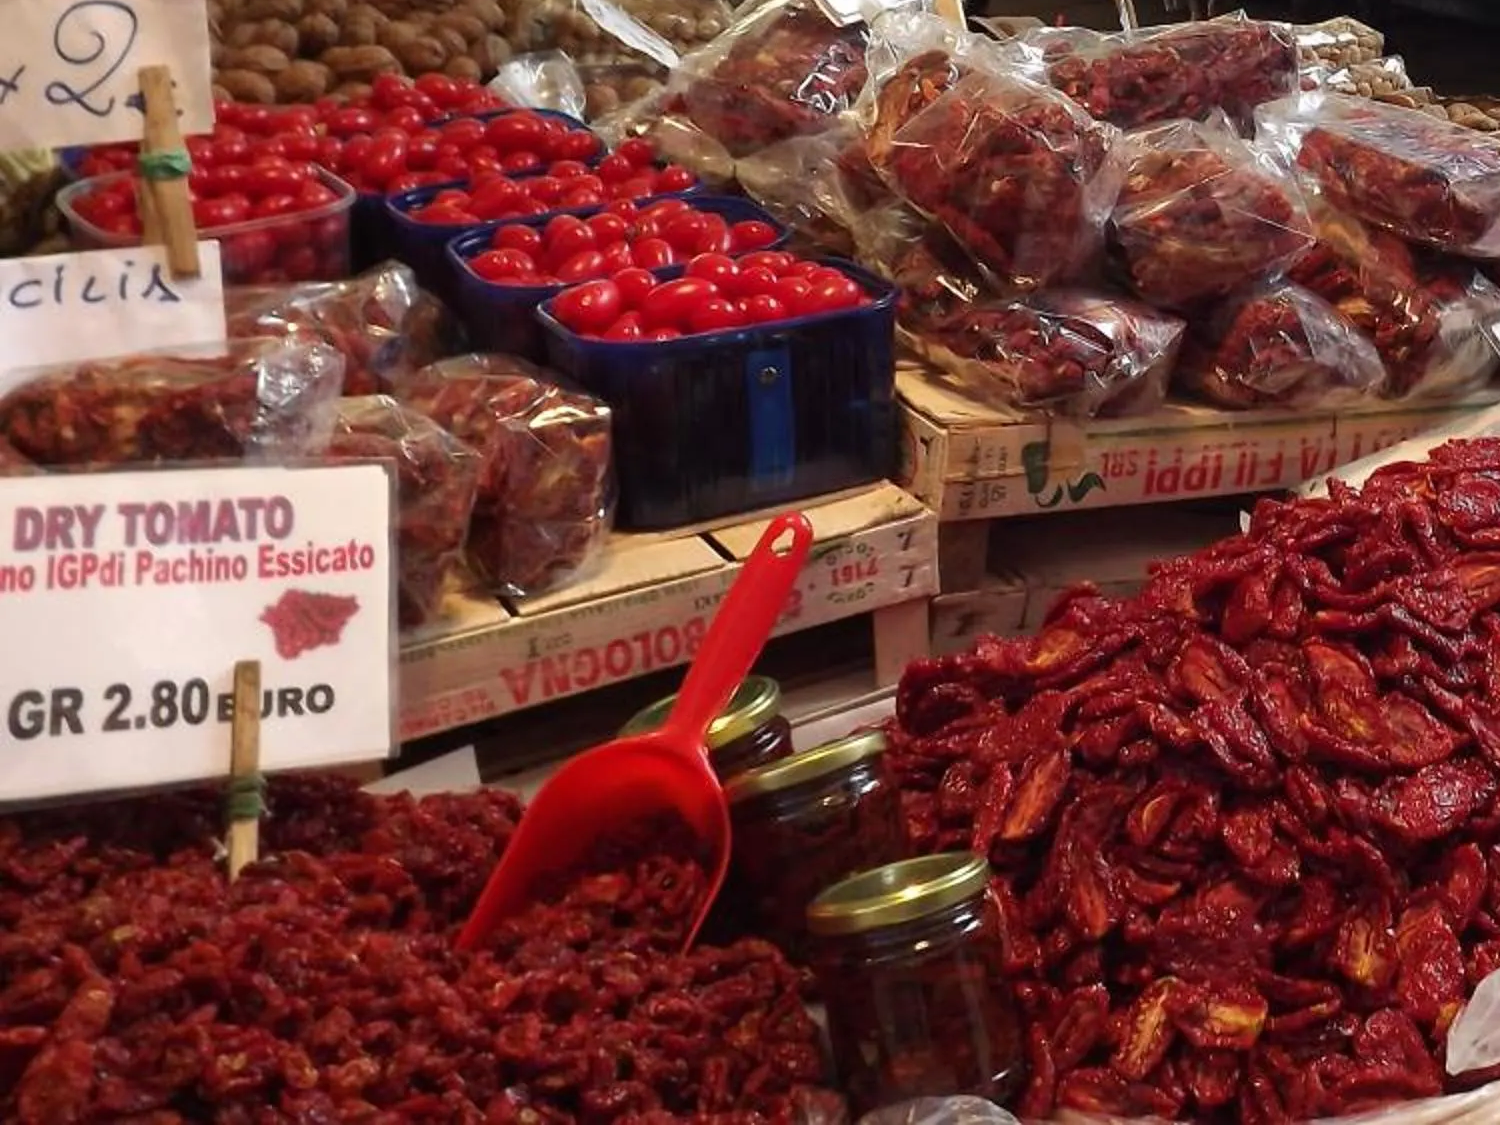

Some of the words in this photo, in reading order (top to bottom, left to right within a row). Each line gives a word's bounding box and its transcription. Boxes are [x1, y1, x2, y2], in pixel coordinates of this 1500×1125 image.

[1100, 449, 1140, 479] SRL
[14, 503, 107, 552] DRY
[117, 495, 295, 548] TOMATO
[134, 546, 249, 586] Pachino
[257, 538, 375, 579] Essicato
[499, 620, 708, 707] BOLOGNA
[7, 687, 85, 741] GR
